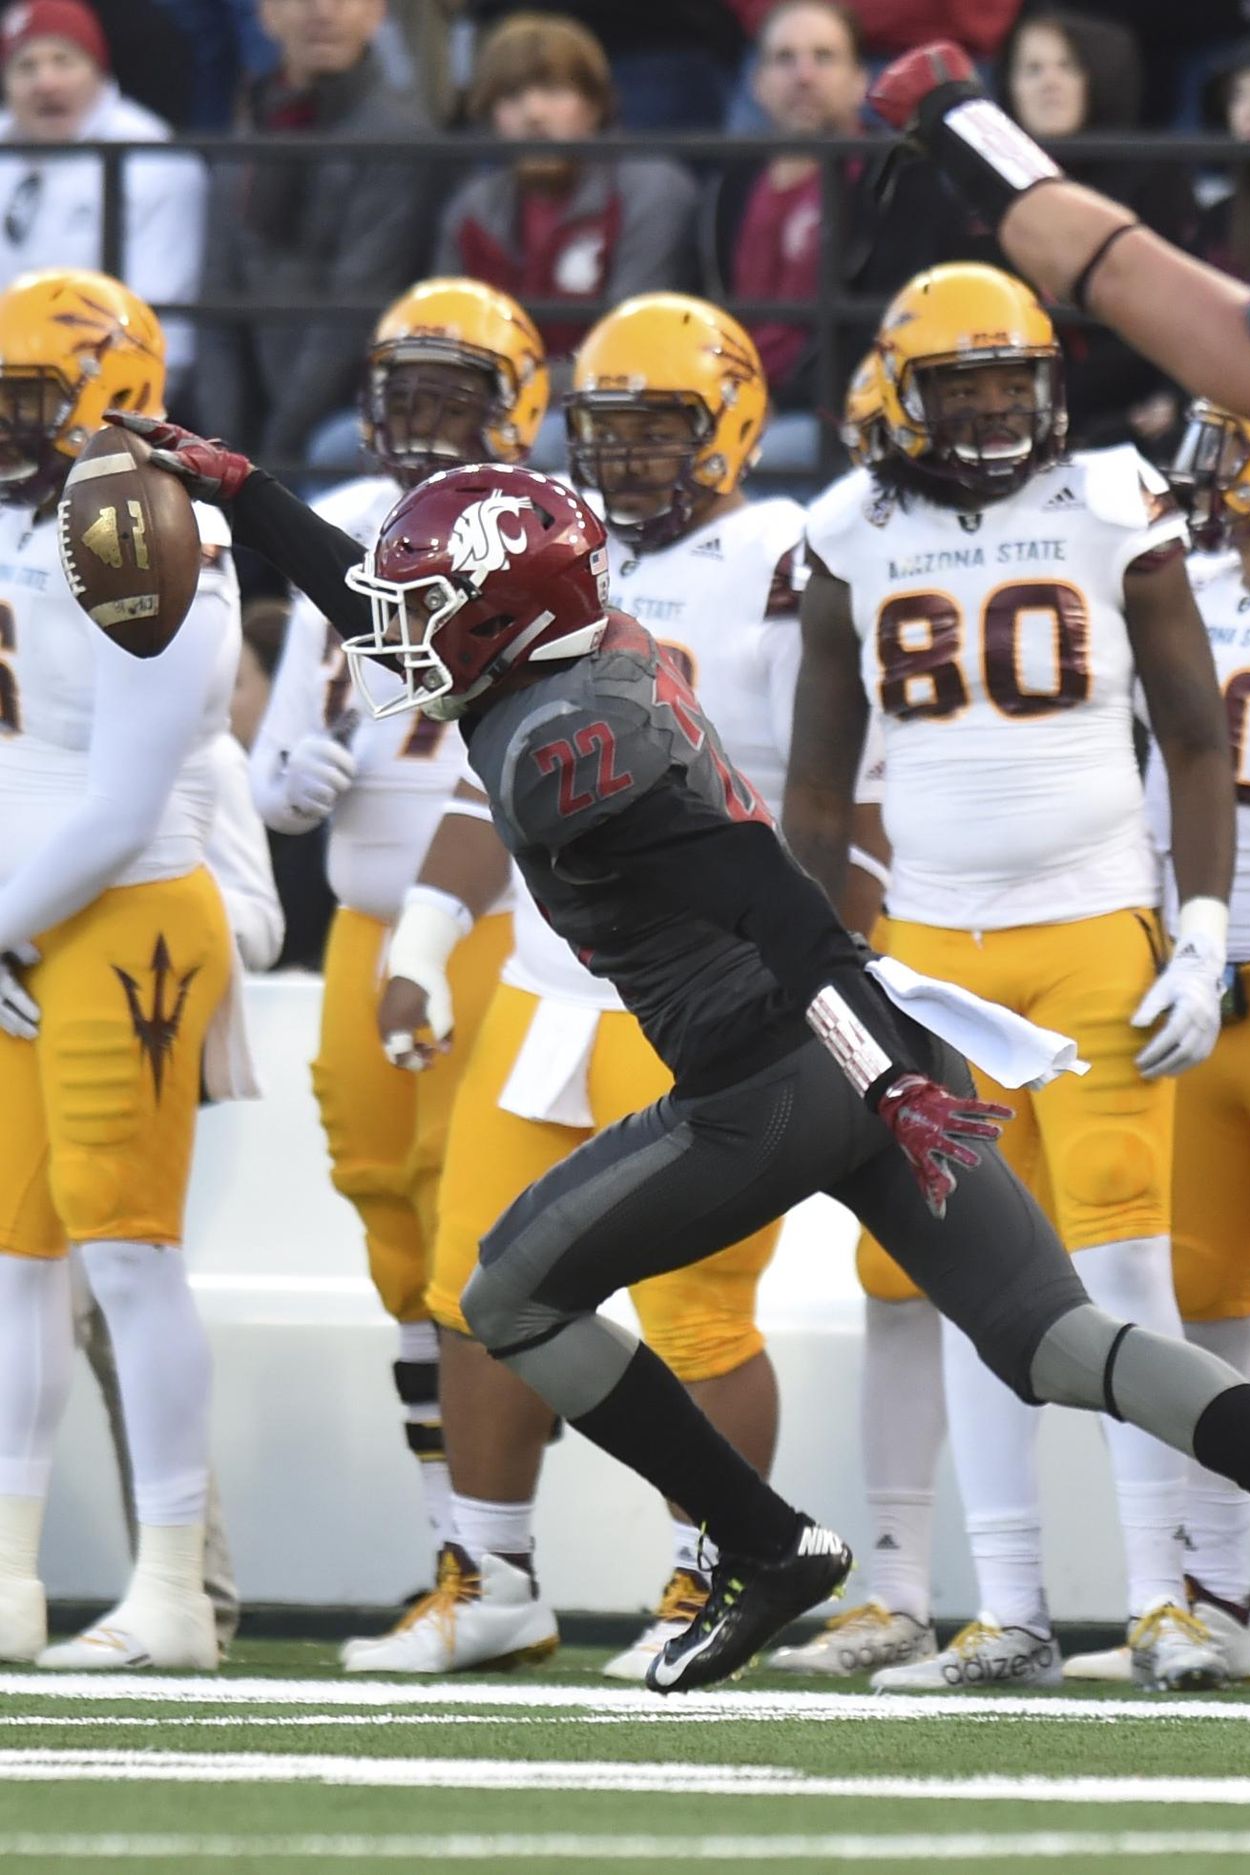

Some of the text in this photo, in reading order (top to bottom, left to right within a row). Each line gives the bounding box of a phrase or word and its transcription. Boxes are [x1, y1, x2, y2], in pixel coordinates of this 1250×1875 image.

[997, 540, 1068, 563] STATE
[875, 577, 1093, 723] 80
[530, 720, 634, 817] 22
[941, 1645, 1053, 1686] adizero
